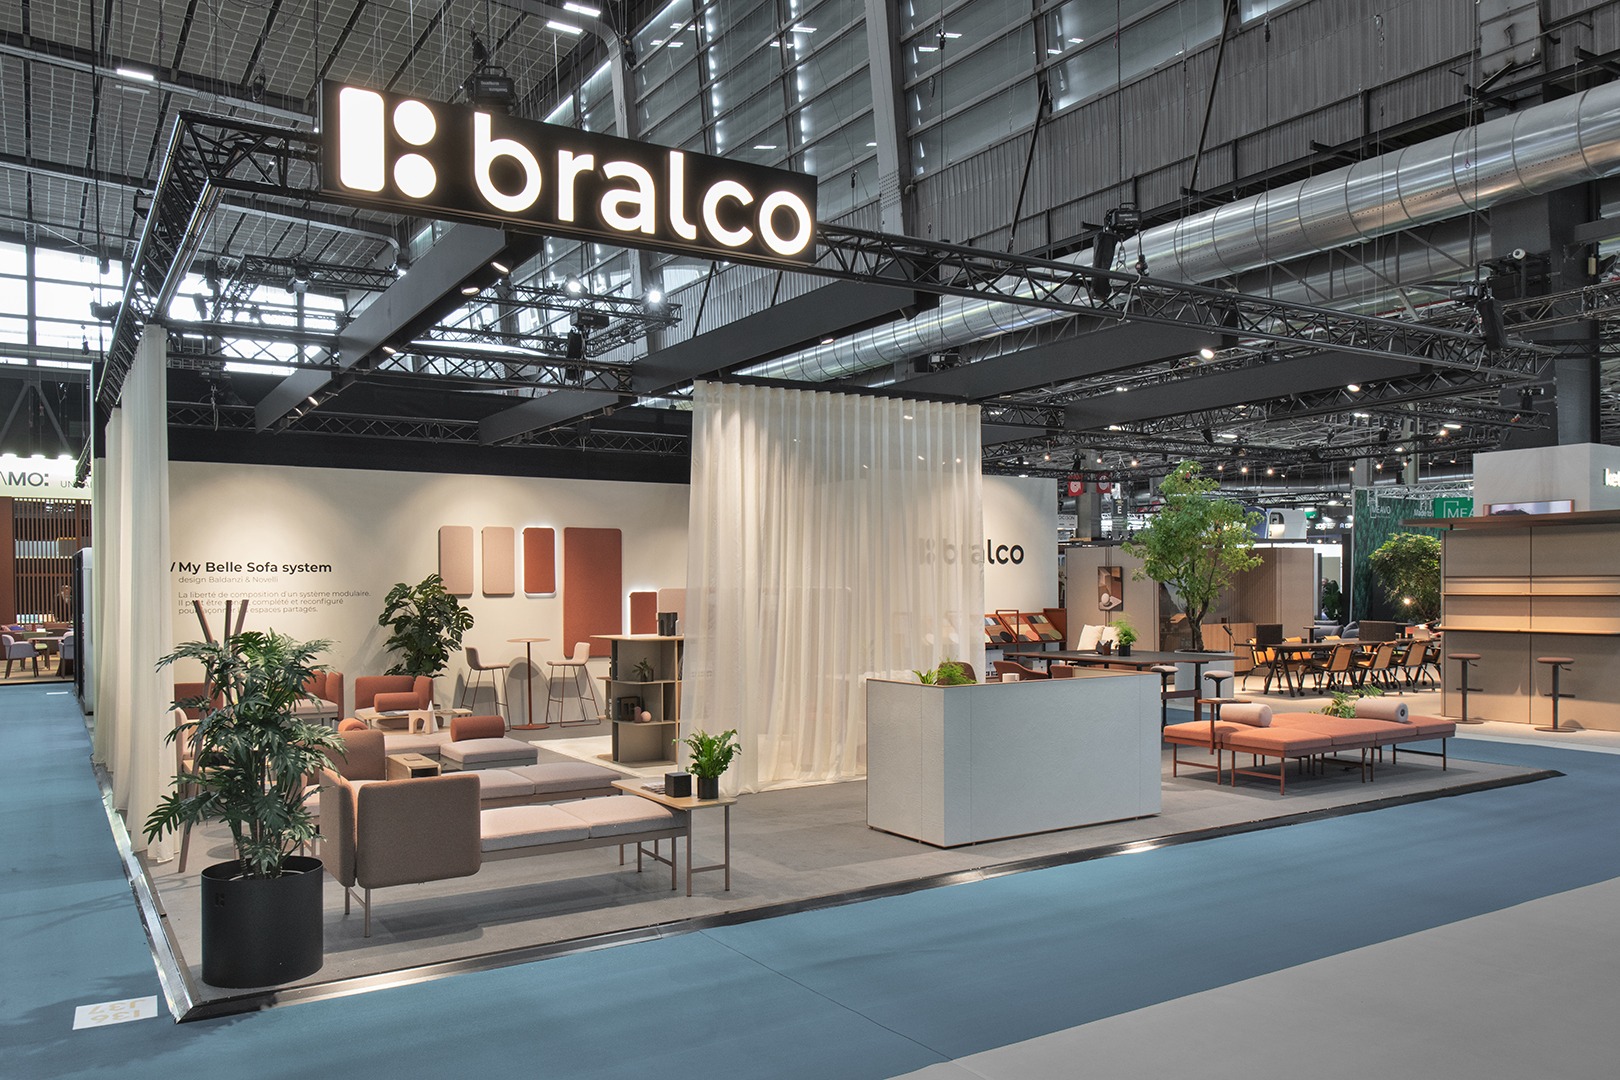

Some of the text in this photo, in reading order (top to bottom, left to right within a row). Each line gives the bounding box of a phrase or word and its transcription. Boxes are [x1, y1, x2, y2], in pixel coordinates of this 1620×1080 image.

[474, 111, 812, 256] bralco
[178, 562, 201, 575] My
[205, 561, 243, 573] Belle
[246, 561, 278, 573] Sofa
[282, 562, 332, 575] system
[178, 576, 207, 585] design
[208, 575, 244, 584] Baldanzi
[178, 591, 188, 599] La
[189, 591, 217, 599] liberté
[230, 590, 279, 600] composition
[299, 590, 331, 599] système
[252, 598, 289, 606] complété
[300, 597, 344, 606] reconfiguré
[249, 606, 282, 614] espaces
